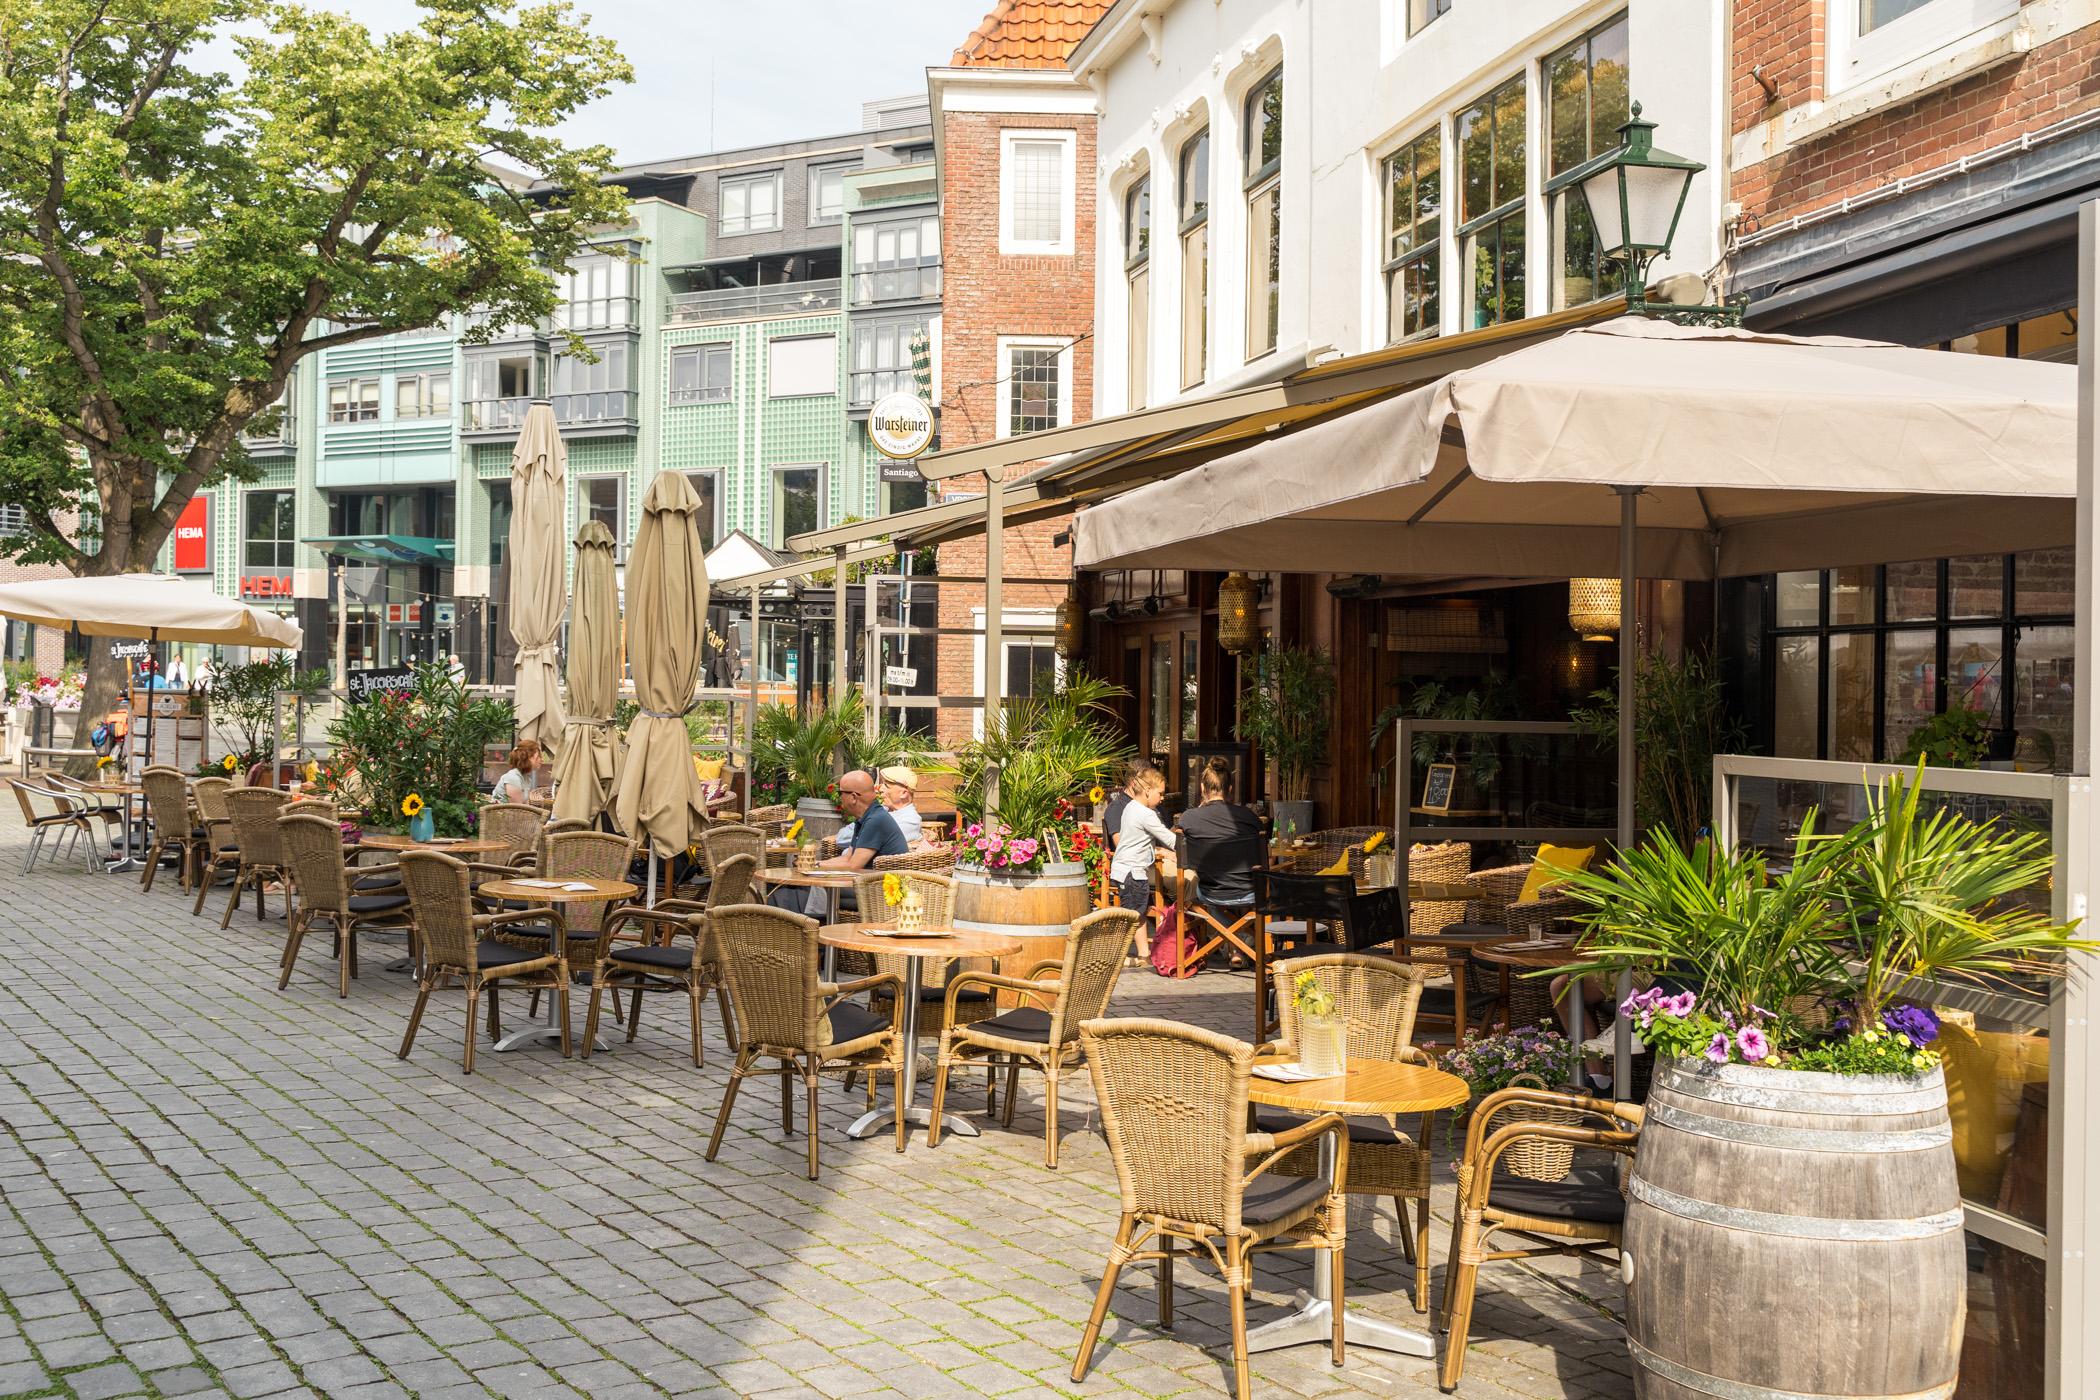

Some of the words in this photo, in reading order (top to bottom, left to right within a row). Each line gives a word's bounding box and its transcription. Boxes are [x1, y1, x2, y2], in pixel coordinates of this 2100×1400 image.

[875, 416, 928, 433] Warsteiner
[884, 468, 919, 478] Santiago
[178, 527, 203, 539] HEMA
[240, 575, 292, 597] HEM
